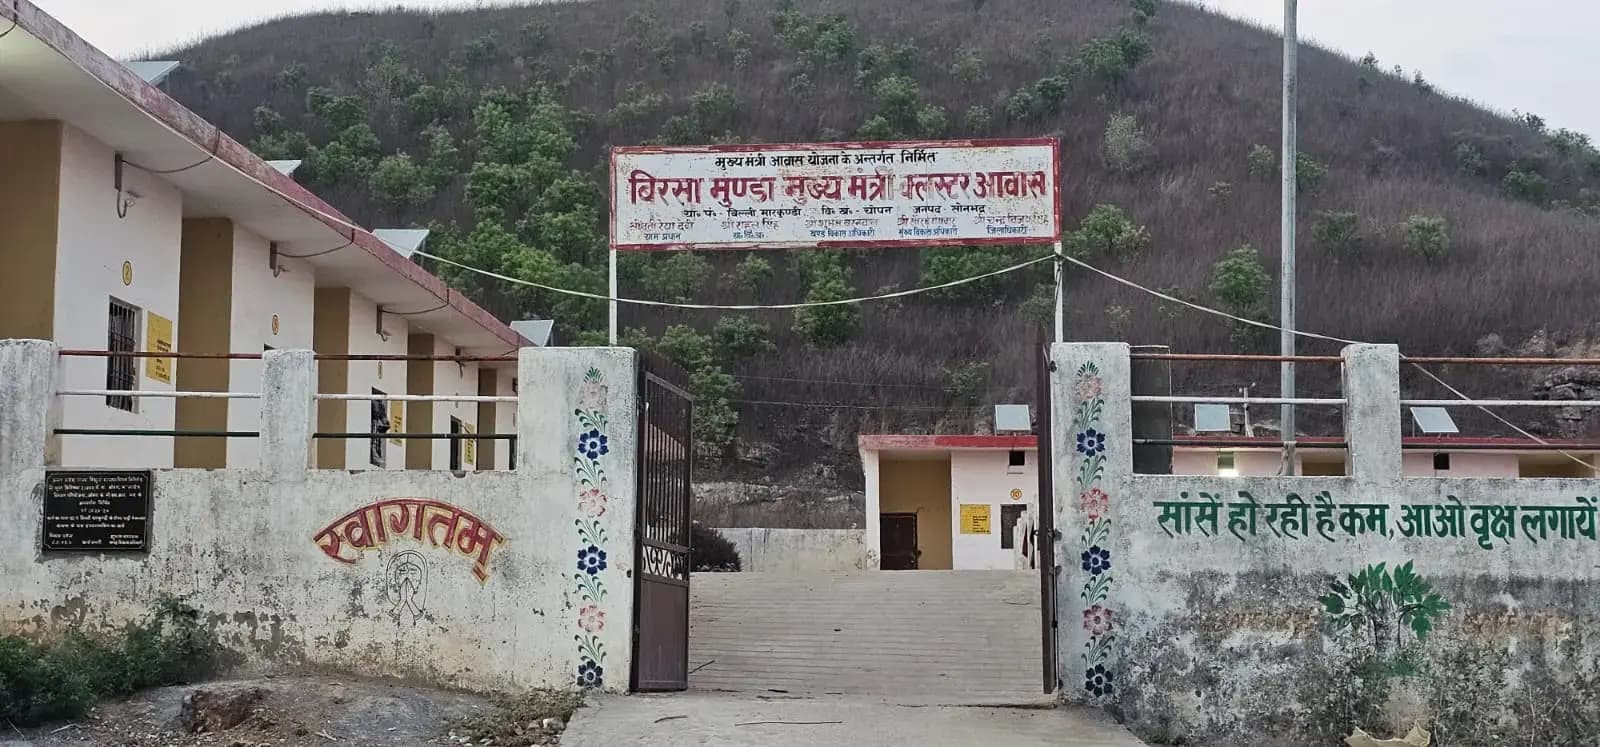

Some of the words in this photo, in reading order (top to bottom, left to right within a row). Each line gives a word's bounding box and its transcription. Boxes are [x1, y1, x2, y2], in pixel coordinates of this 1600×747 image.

[715, 156, 743, 171] मुख्य
[745, 153, 765, 167] मंत्री
[771, 153, 805, 167] आवास
[807, 151, 840, 166] योजना
[841, 151, 852, 165] के
[901, 149, 938, 165] निर्मित
[710, 176, 777, 208] मुण्डा
[783, 175, 844, 206] मुख्य
[973, 170, 1046, 199] आवास
[913, 205, 942, 214] जनपद
[1152, 490, 1223, 538] सांसें
[1227, 490, 1261, 542] हो
[1264, 491, 1311, 540] रही
[1313, 490, 1336, 542] है
[1396, 494, 1466, 538] आओ
[1470, 503, 1517, 551] वृक्ष
[1520, 496, 1598, 544] लगायें
